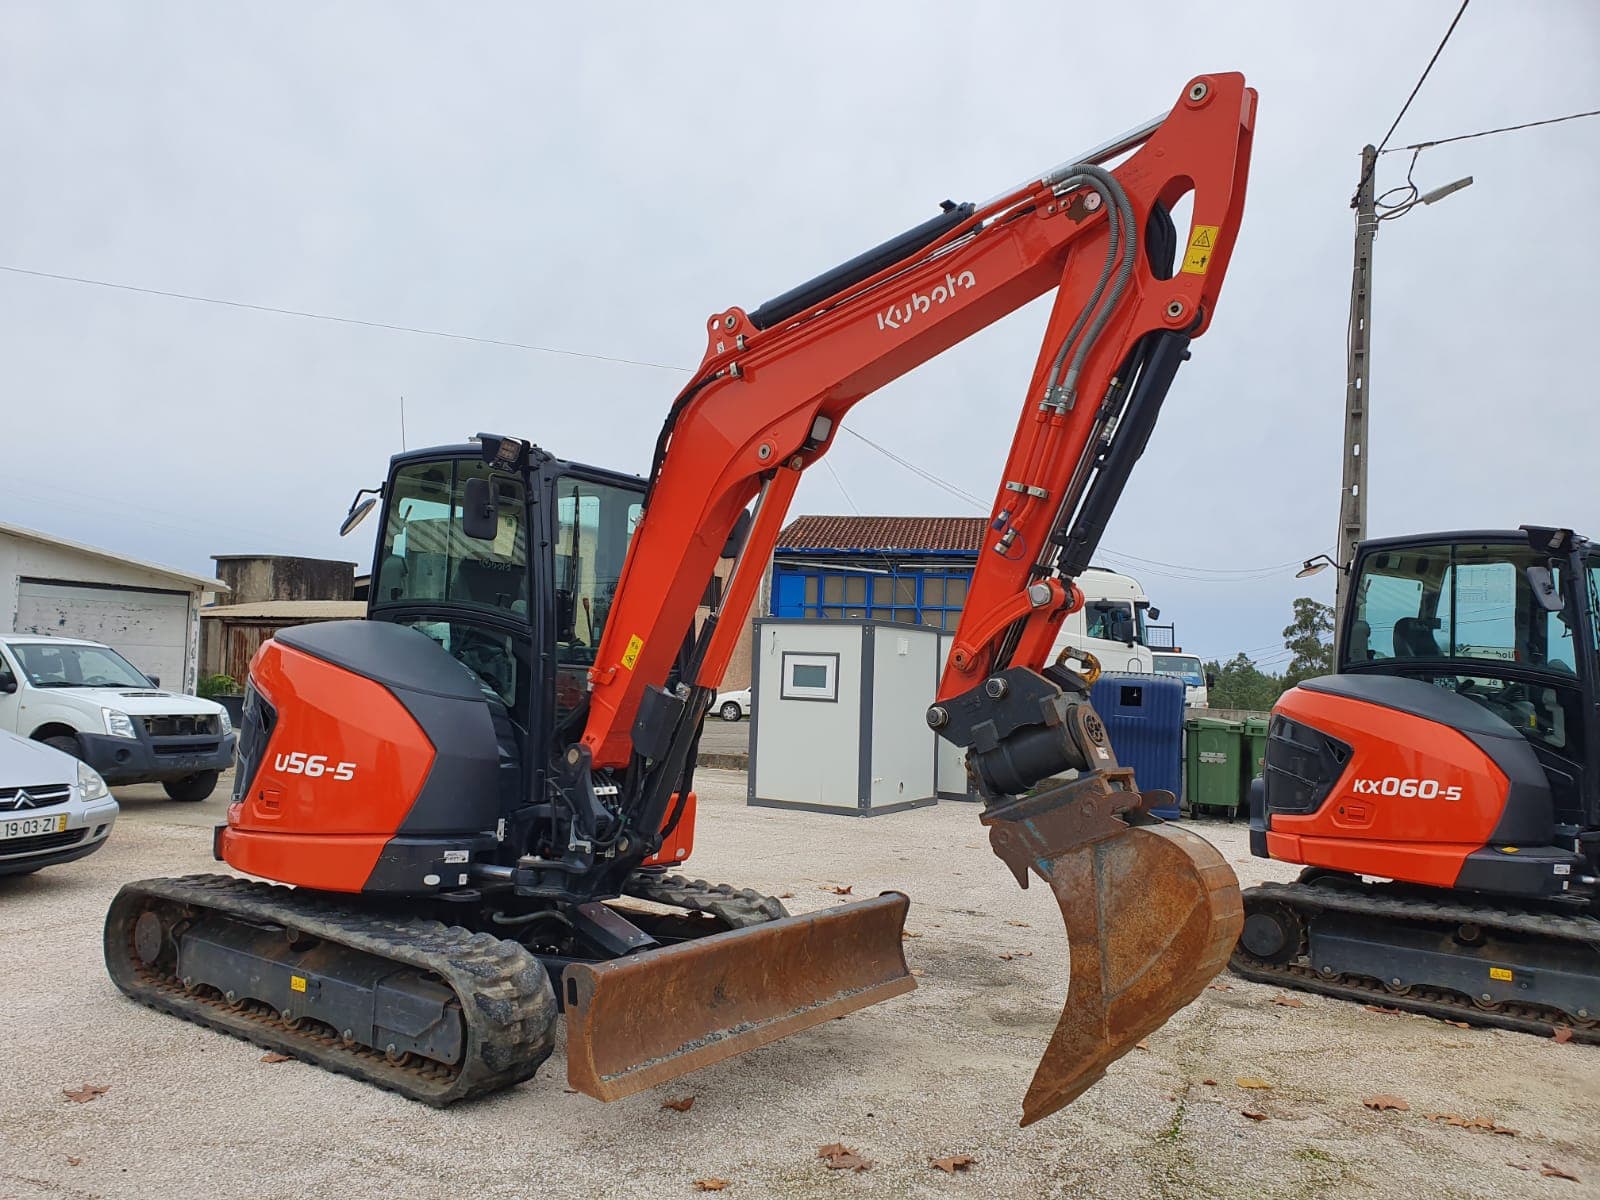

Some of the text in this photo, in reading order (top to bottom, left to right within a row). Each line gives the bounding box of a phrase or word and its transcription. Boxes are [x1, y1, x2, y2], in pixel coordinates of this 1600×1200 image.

[877, 270, 976, 330] Kubota
[274, 751, 357, 781] U56-5
[1352, 777, 1462, 801] KX060-5
